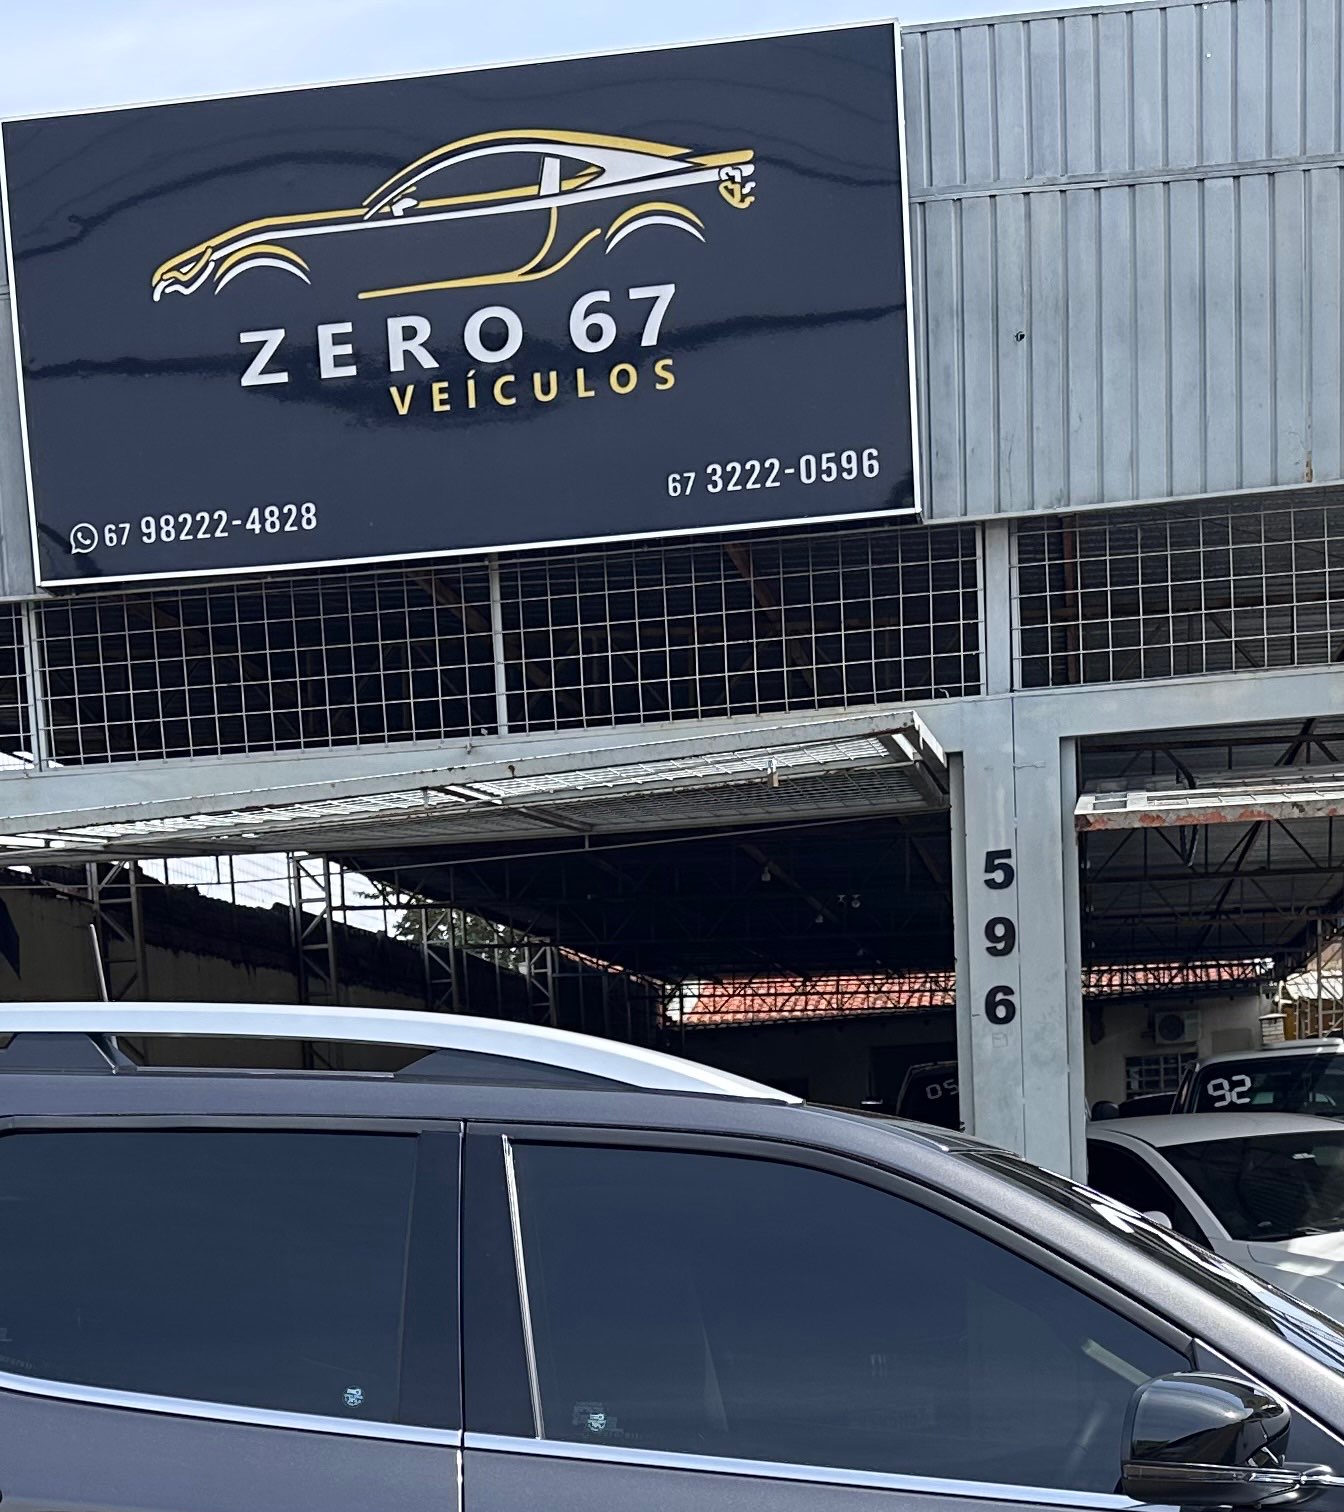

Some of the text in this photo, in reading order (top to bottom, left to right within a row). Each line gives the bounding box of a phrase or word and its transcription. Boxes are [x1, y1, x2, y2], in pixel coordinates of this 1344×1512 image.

[239, 283, 676, 387] ZERO 67
[389, 358, 675, 415] VEÍCULOS
[667, 448, 879, 497] 67 3222-0596
[104, 502, 317, 547] 67 98222-4828
[1207, 1074, 1252, 1107] 92
